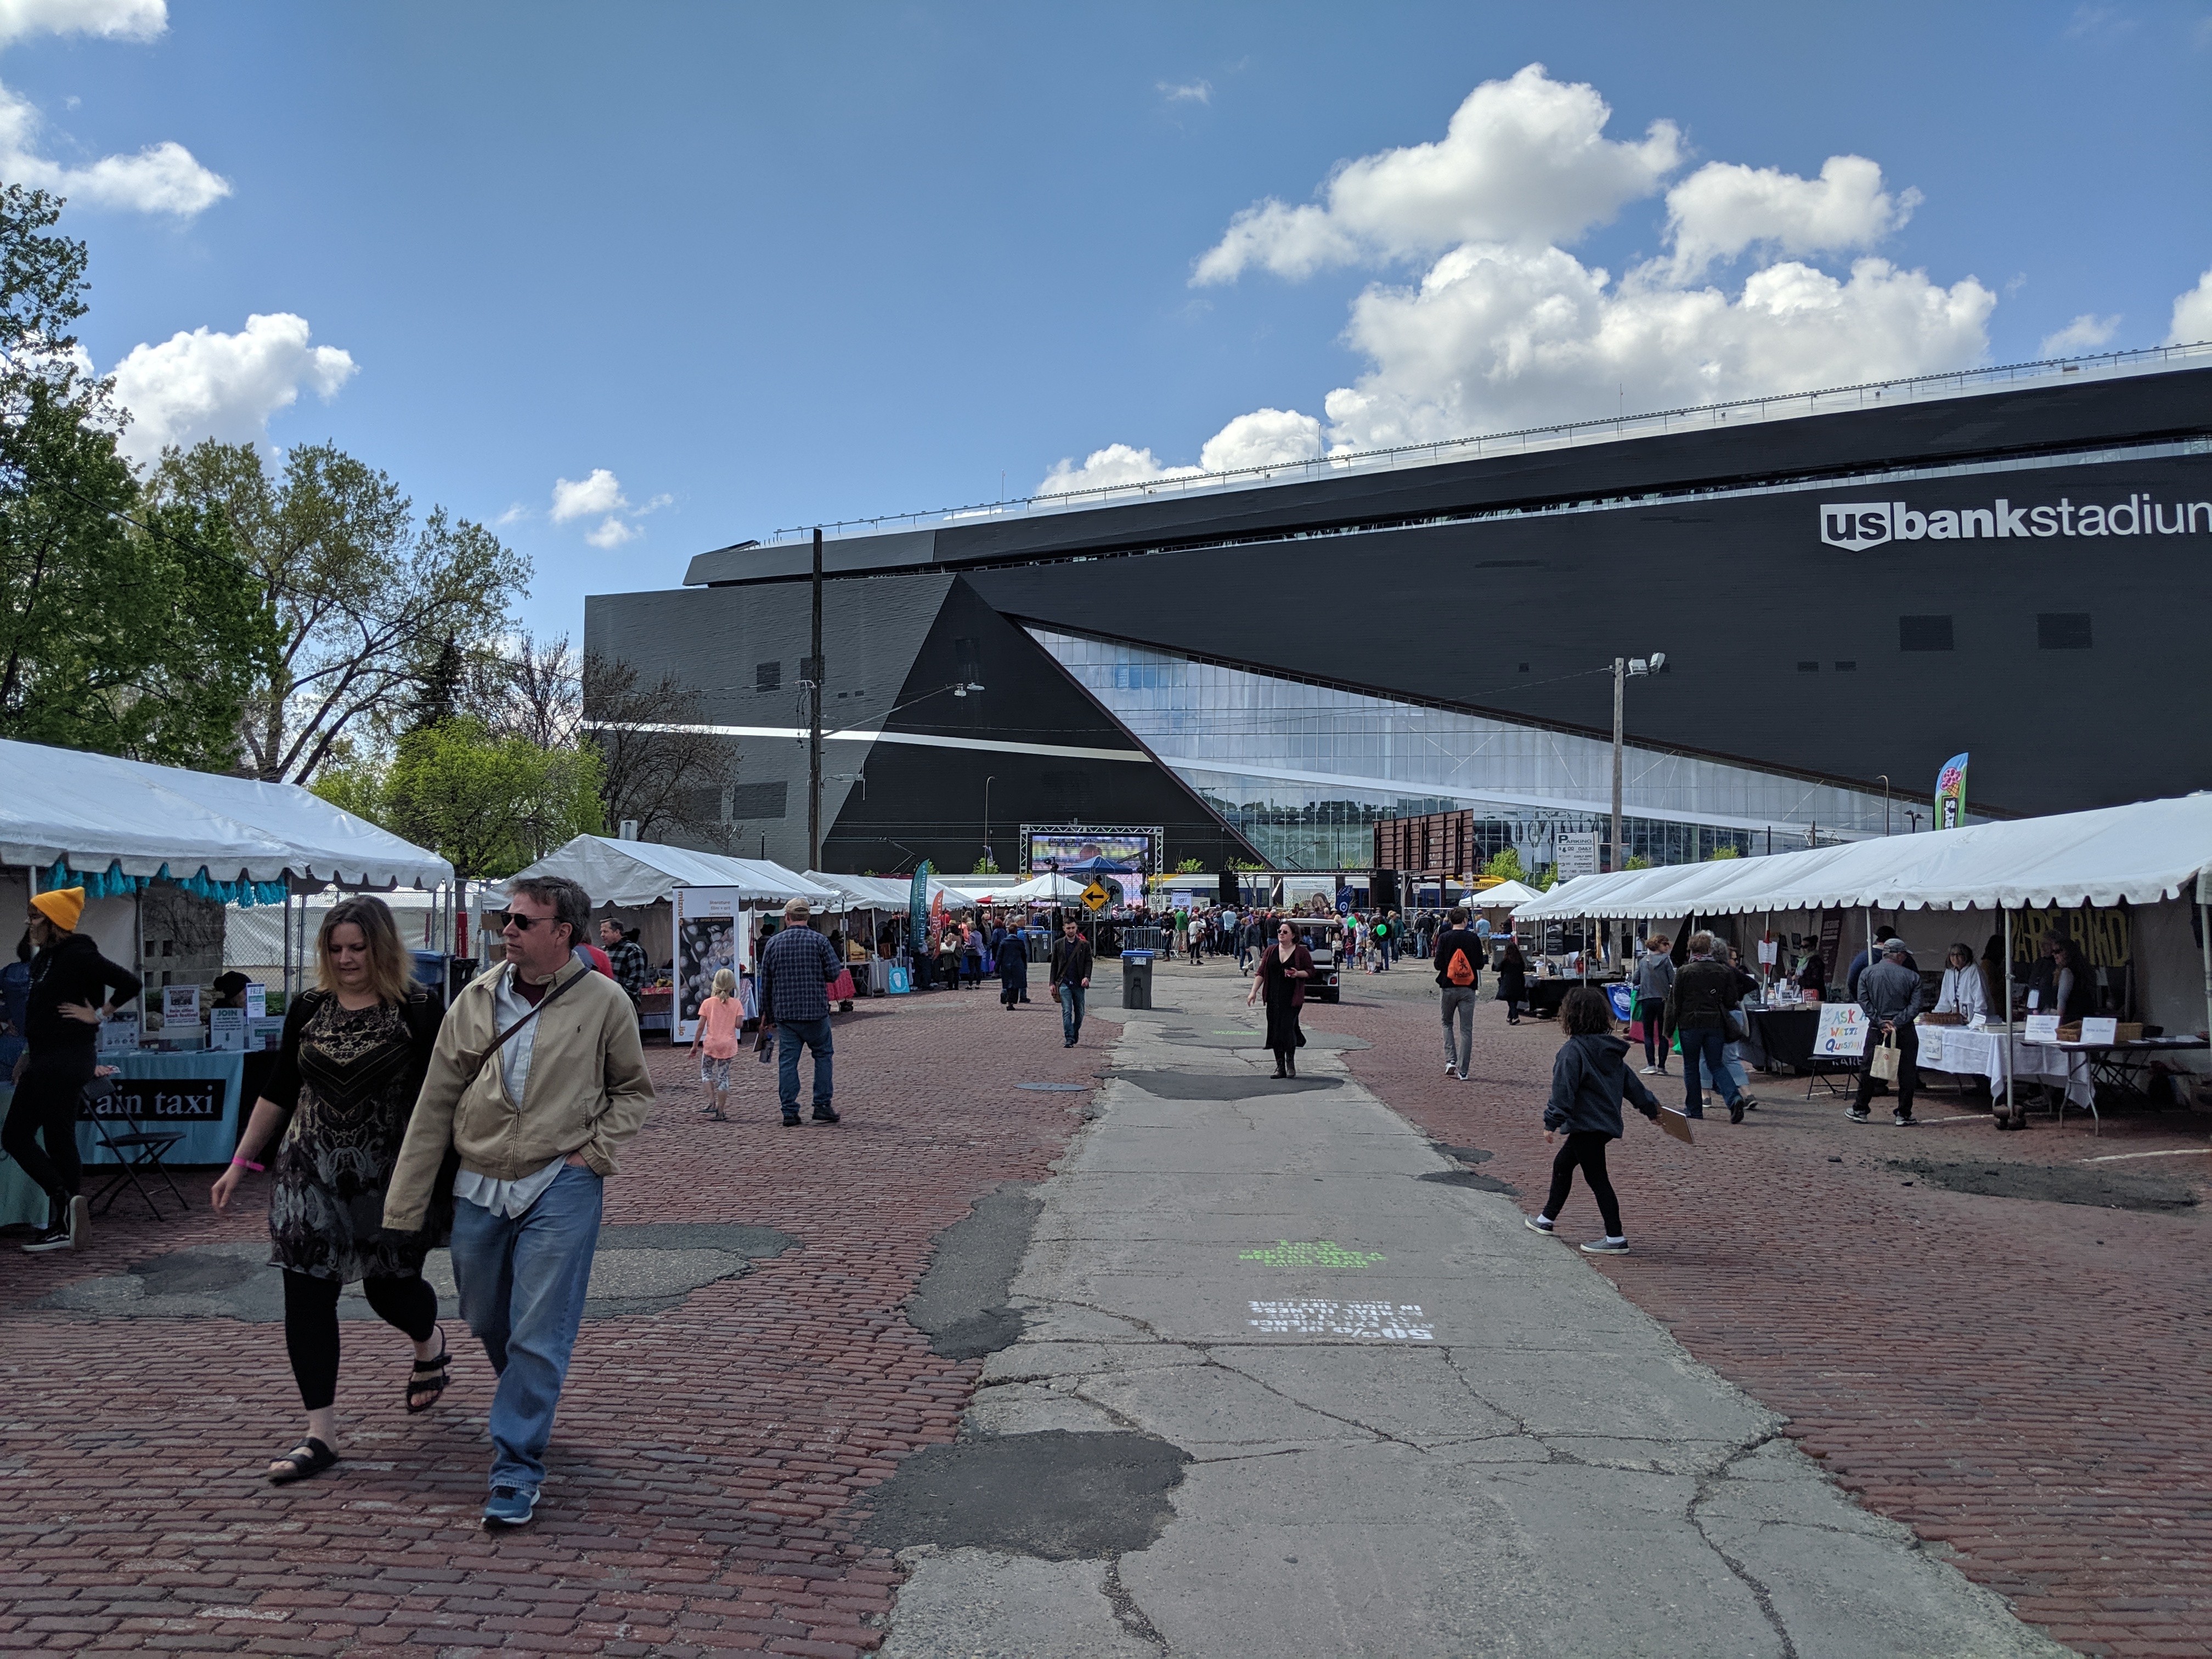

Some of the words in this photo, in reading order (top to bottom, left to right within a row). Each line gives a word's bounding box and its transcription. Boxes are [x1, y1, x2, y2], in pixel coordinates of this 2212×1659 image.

[1944, 800, 1956, 829] RY'S
[1559, 835, 1592, 844] PARKING
[1831, 1008, 1856, 1025] ASK
[1830, 1026, 1863, 1037] WRITE
[155, 1085, 213, 1114] taxi
[1248, 1301, 1339, 1309] LIFETIME
[1331, 1328, 1434, 1340] 50%
